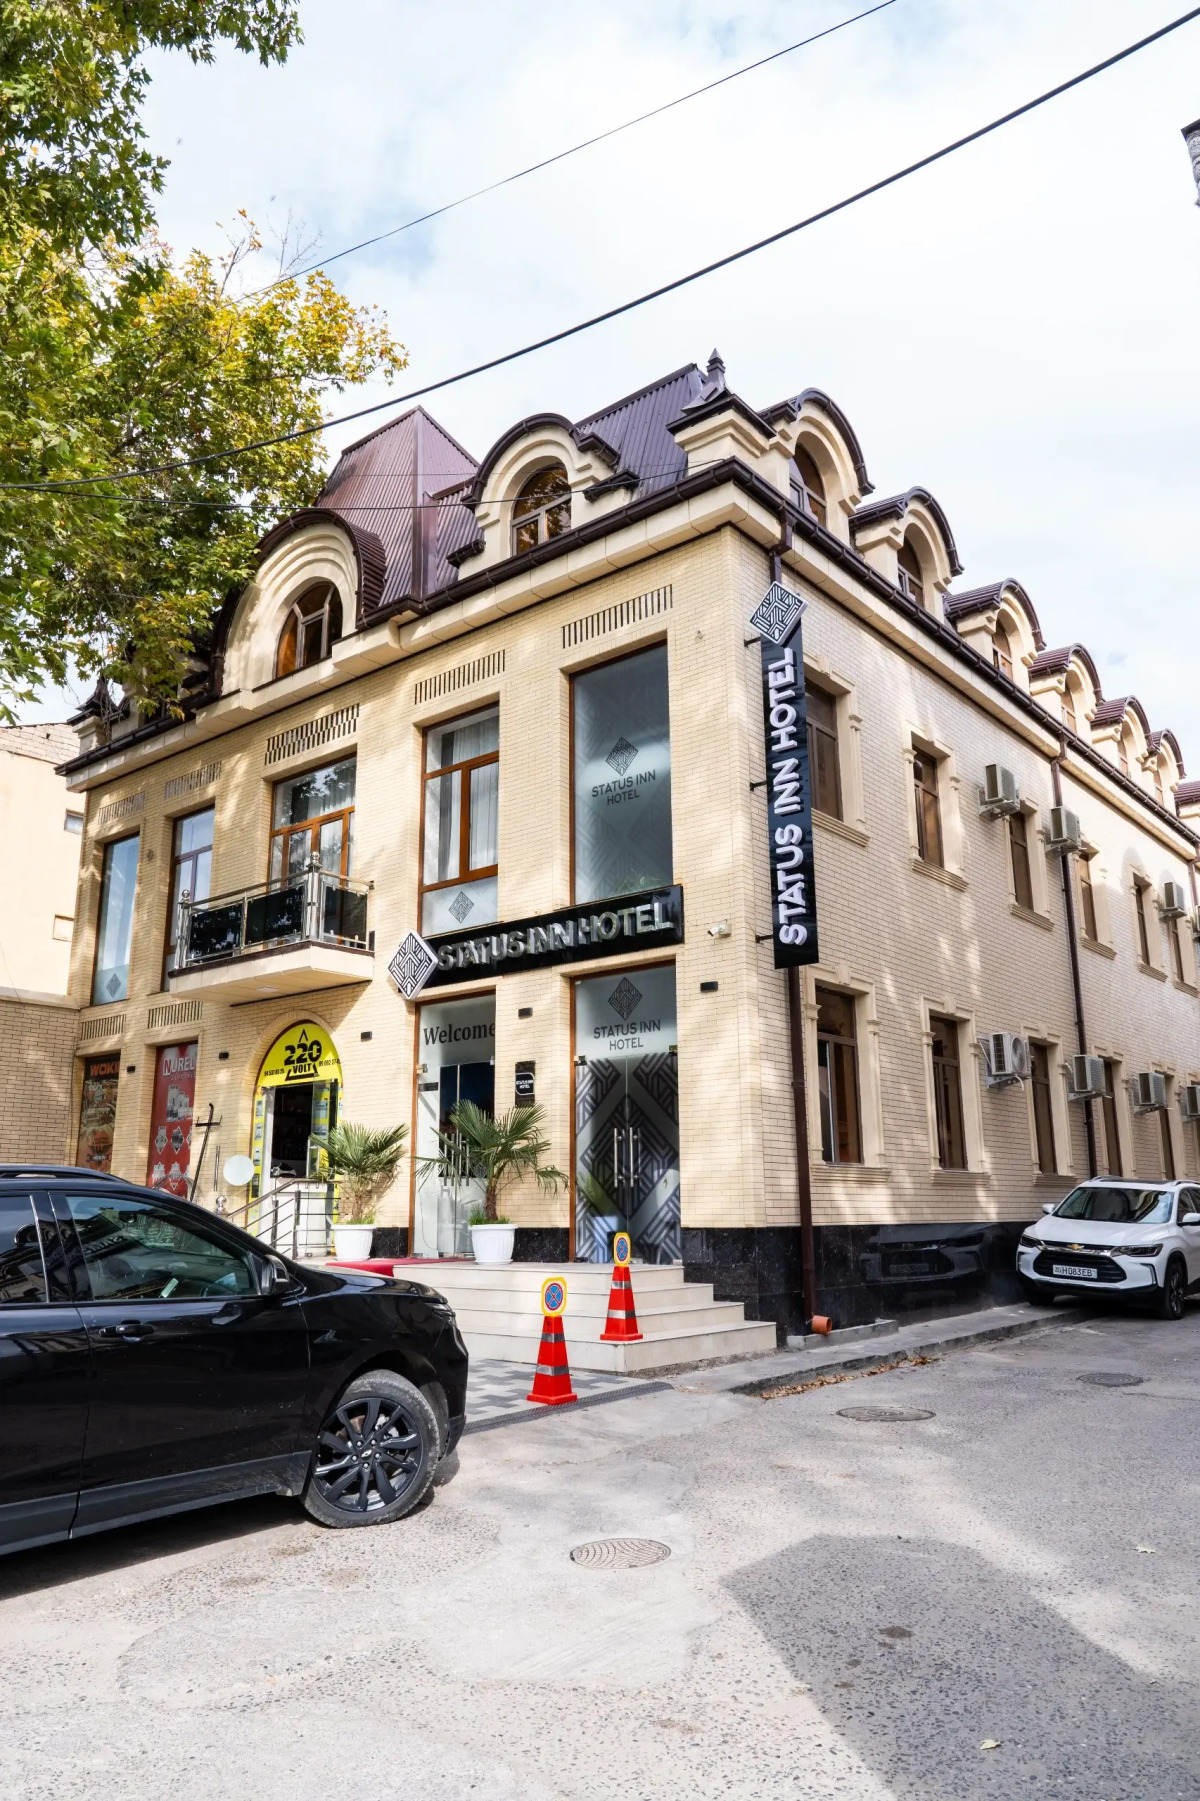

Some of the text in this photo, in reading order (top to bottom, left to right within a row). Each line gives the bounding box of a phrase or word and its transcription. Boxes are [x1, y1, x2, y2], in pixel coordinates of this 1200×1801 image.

[592, 769, 656, 798] STATUS INN
[607, 788, 640, 806] HOTEL
[768, 647, 808, 945] STATUS INN HOTEL
[437, 902, 674, 971] STATUS INN HOTEL
[423, 1022, 496, 1046] Welcome
[593, 1019, 661, 1039] STATUS INN
[284, 1039, 322, 1066] 220
[609, 1036, 644, 1051] HOTEL
[292, 1062, 312, 1074] VOLT
